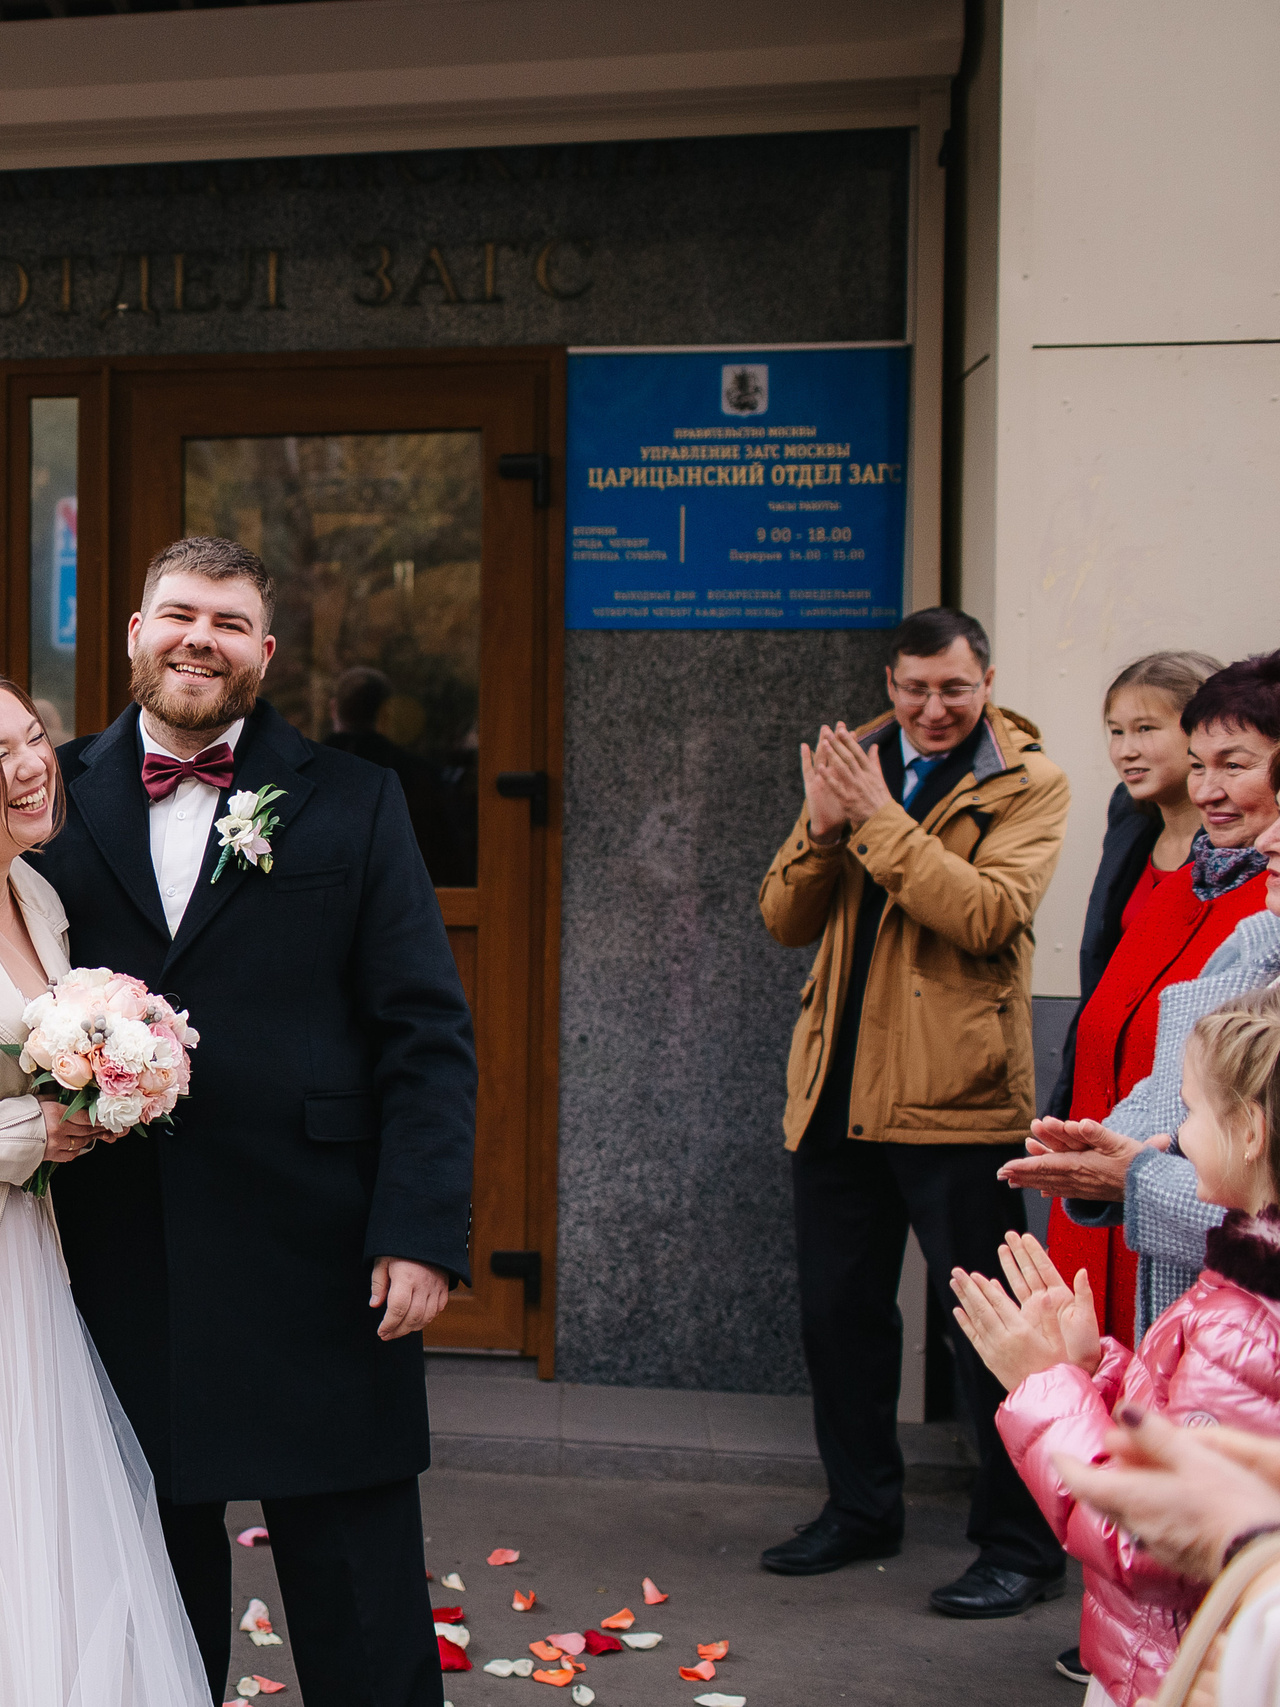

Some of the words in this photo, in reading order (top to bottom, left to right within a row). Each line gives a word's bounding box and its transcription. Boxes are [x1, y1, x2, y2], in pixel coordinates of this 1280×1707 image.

[353, 241, 594, 307] ЗАГС
[767, 426, 816, 437] МОСКВЫ
[641, 445, 740, 460] УПРАВЛЕНИЕ
[745, 444, 780, 459] ЗАГС
[784, 443, 850, 458] МОСКВЫ
[588, 462, 765, 491] ЦАРИЦЫНСКИЙ
[771, 464, 841, 488] ОТДЕЛ
[848, 463, 903, 484] ЗАГС
